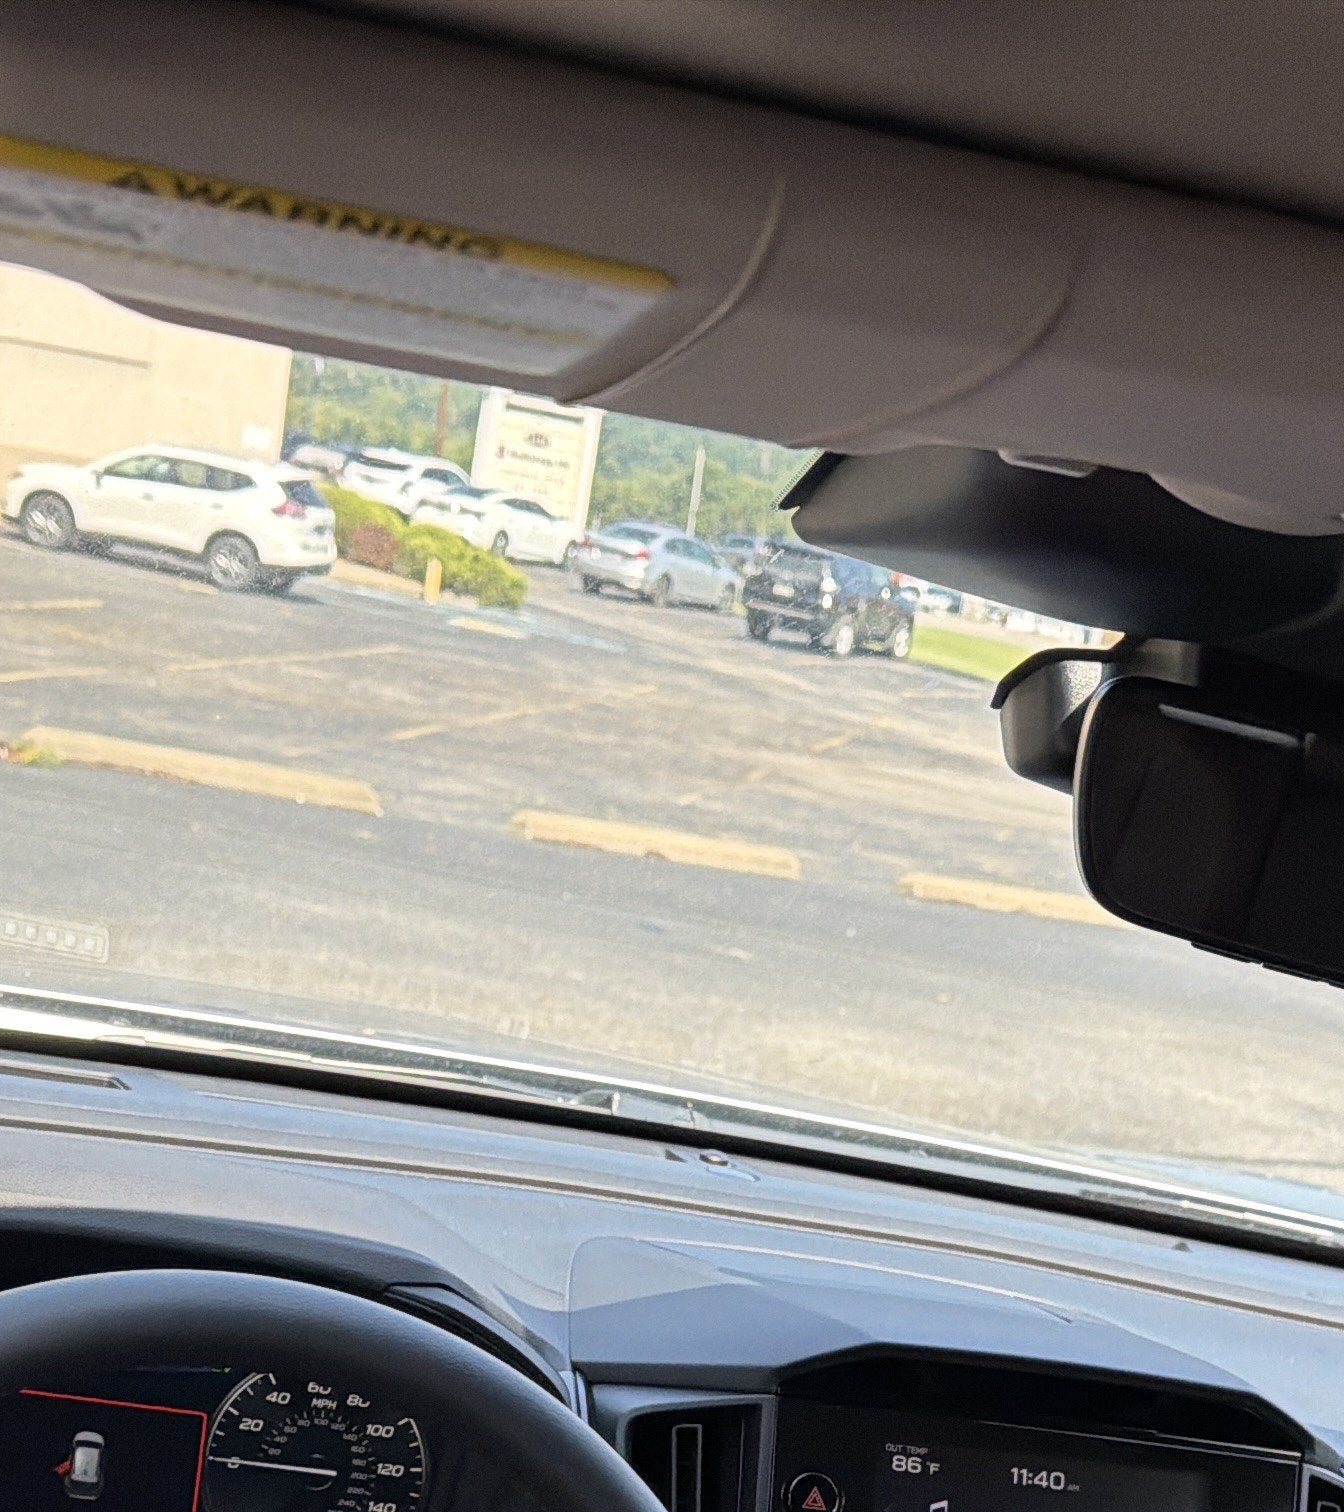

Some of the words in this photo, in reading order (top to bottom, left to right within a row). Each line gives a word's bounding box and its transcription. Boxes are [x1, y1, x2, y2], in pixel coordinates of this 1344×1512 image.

[171, 171, 506, 261] WARNING
[265, 1391, 291, 1405] 40
[311, 1397, 338, 1410] MPH
[239, 1417, 264, 1432] 20
[365, 1424, 395, 1438] 100
[886, 1444, 907, 1454] OUT
[376, 1463, 405, 1477] 120
[891, 1455, 922, 1475] 86
[1011, 1467, 1065, 1491] 11:40
